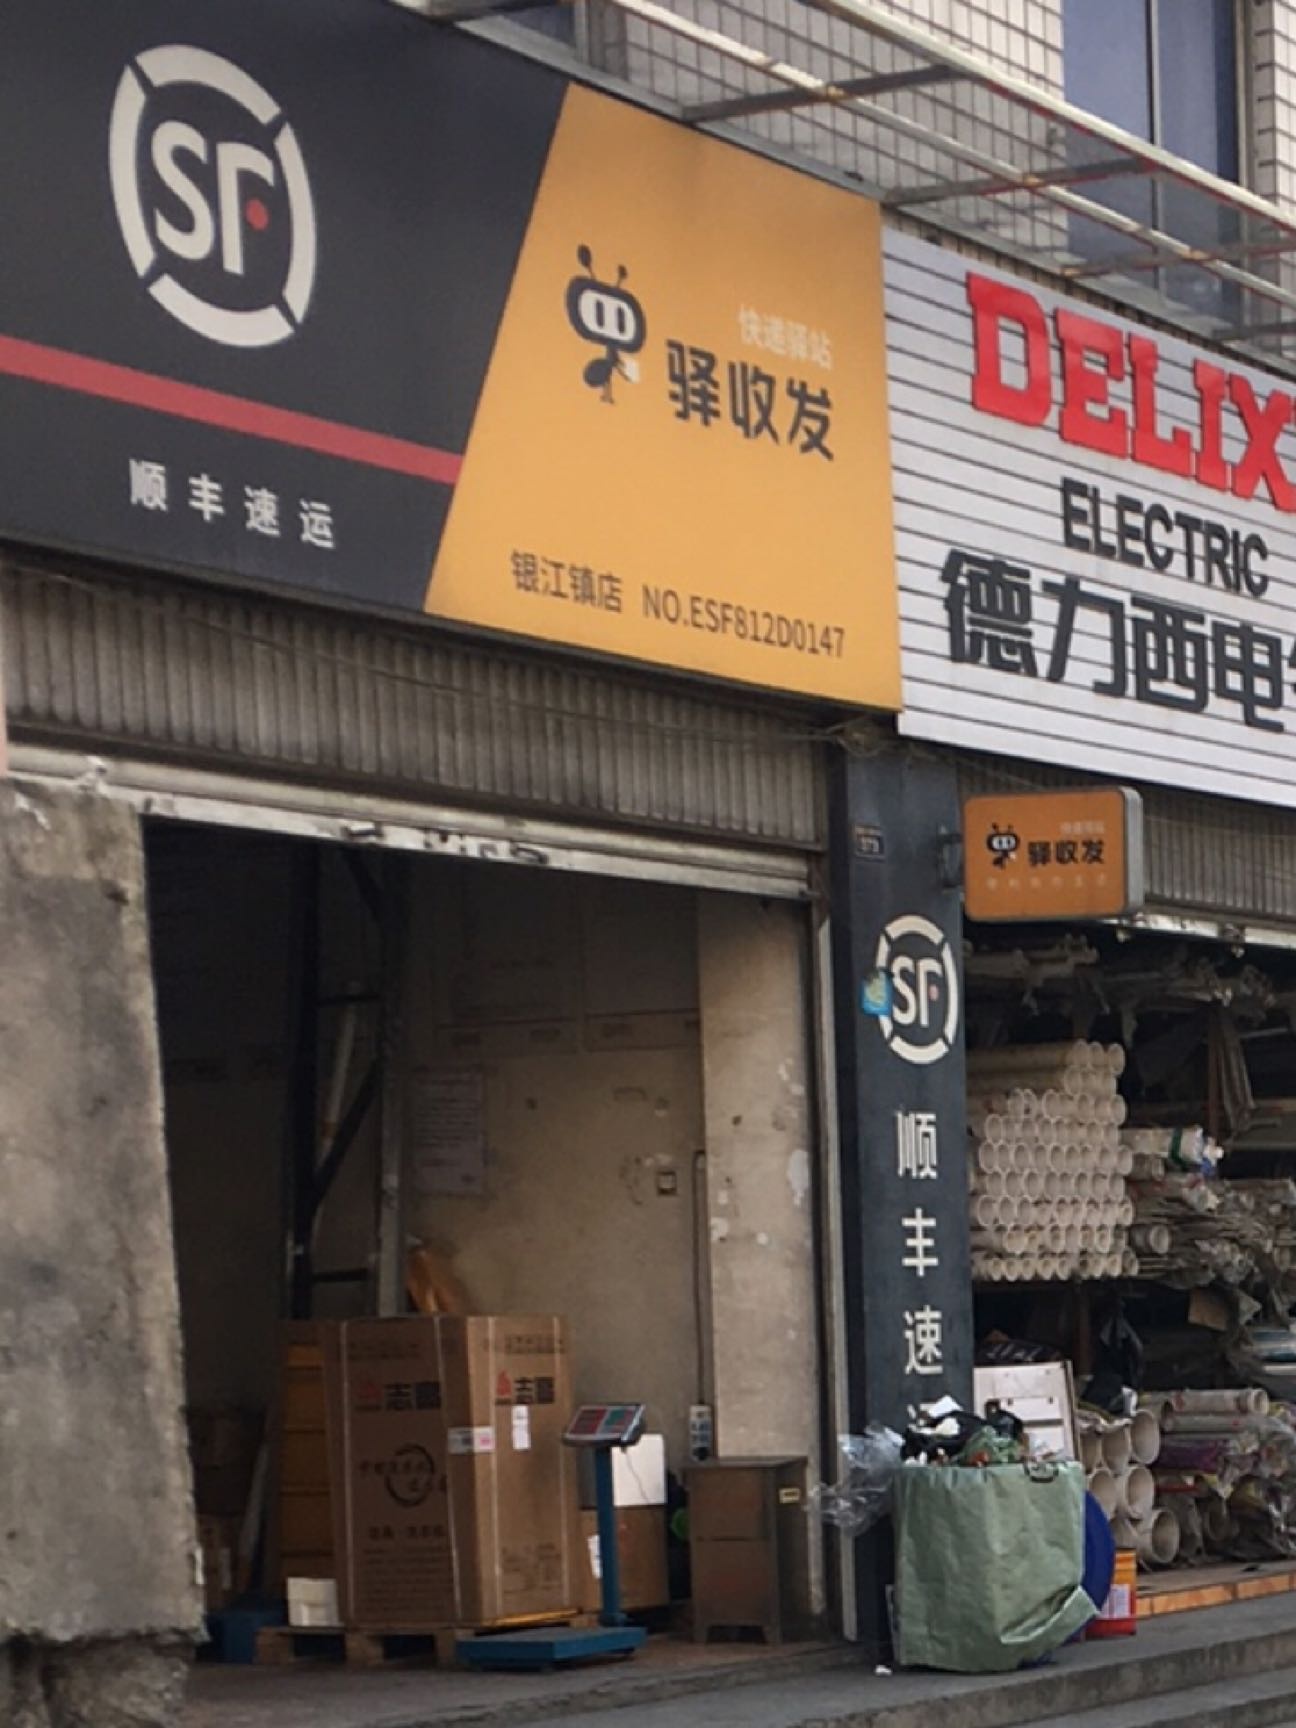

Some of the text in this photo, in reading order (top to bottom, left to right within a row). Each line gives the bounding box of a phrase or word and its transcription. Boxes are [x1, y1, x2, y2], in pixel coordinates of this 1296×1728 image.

[152, 119, 275, 277] SF
[666, 338, 836, 462] 驿收发
[128, 458, 335, 549] 顺丰速运
[1061, 476, 1269, 598] ELECTRIC
[511, 548, 845, 658] 银江镇店 NO.ESF812D0147
[1028, 839, 1105, 867] 驿收发
[892, 957, 942, 1028] SF
[896, 1109, 943, 1430] 顺丰速
